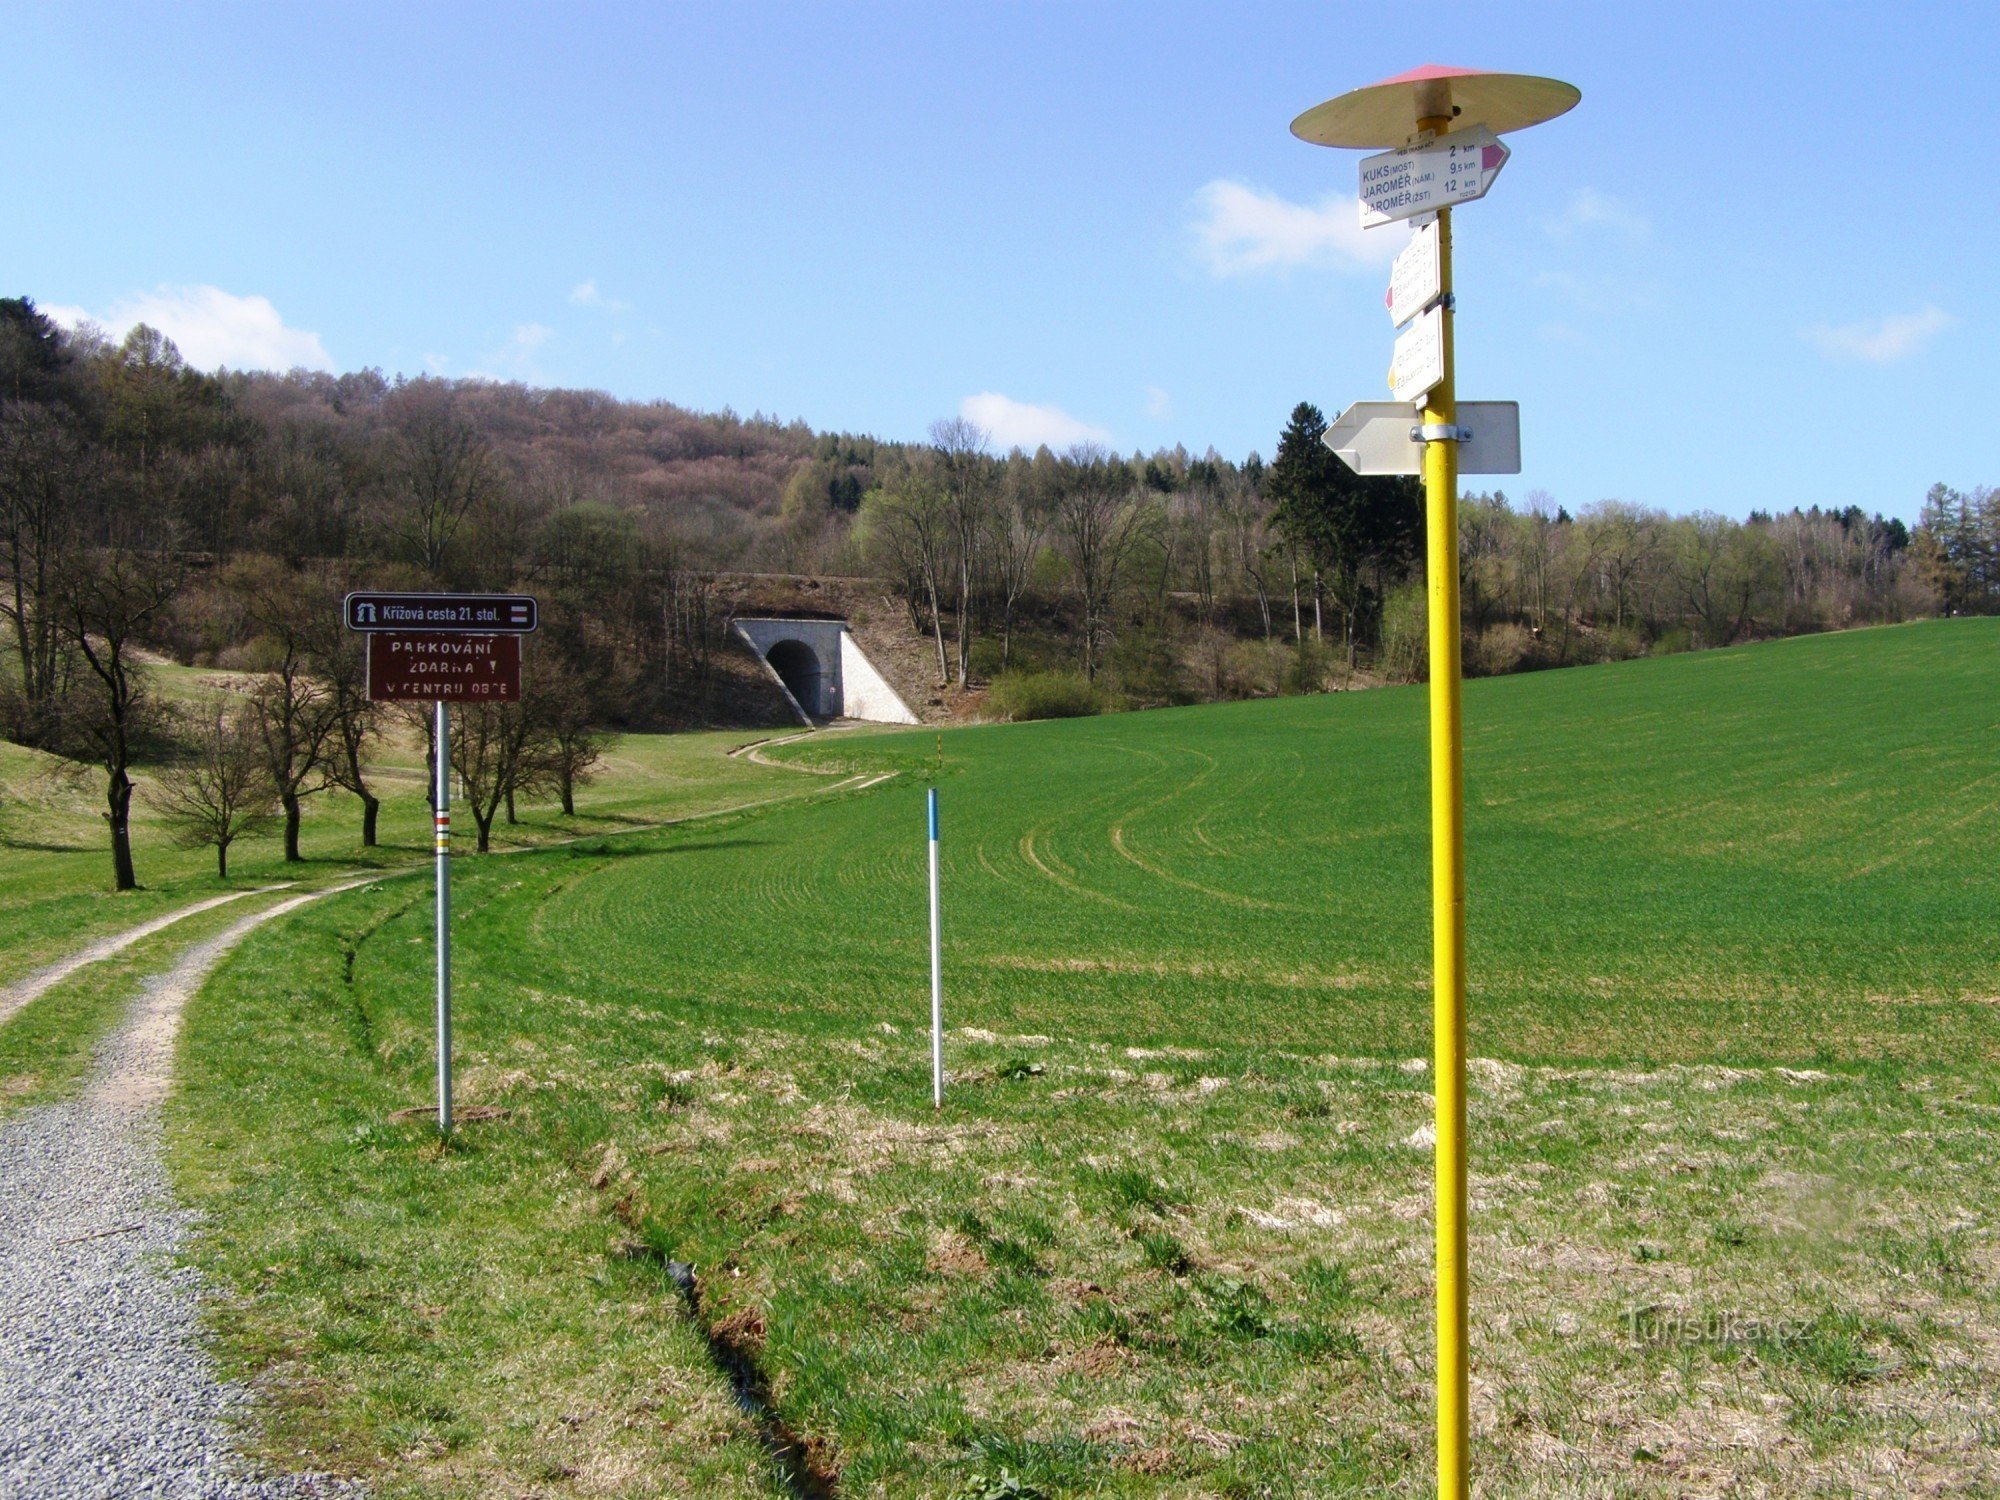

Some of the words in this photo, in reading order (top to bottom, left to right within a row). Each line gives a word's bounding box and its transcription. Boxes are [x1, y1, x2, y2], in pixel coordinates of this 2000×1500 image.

[1450, 145, 1456, 158] 2
[1463, 144, 1475, 153] km
[1464, 161, 1476, 170] km
[1444, 179, 1457, 193] 12
[1464, 180, 1476, 189] km
[383, 605, 424, 620] Křížová
[426, 608, 457, 620] cesta
[459, 607, 474, 621] 21.
[476, 607, 500, 621] stol.
[391, 639, 493, 655] PARKOVÁNÍ
